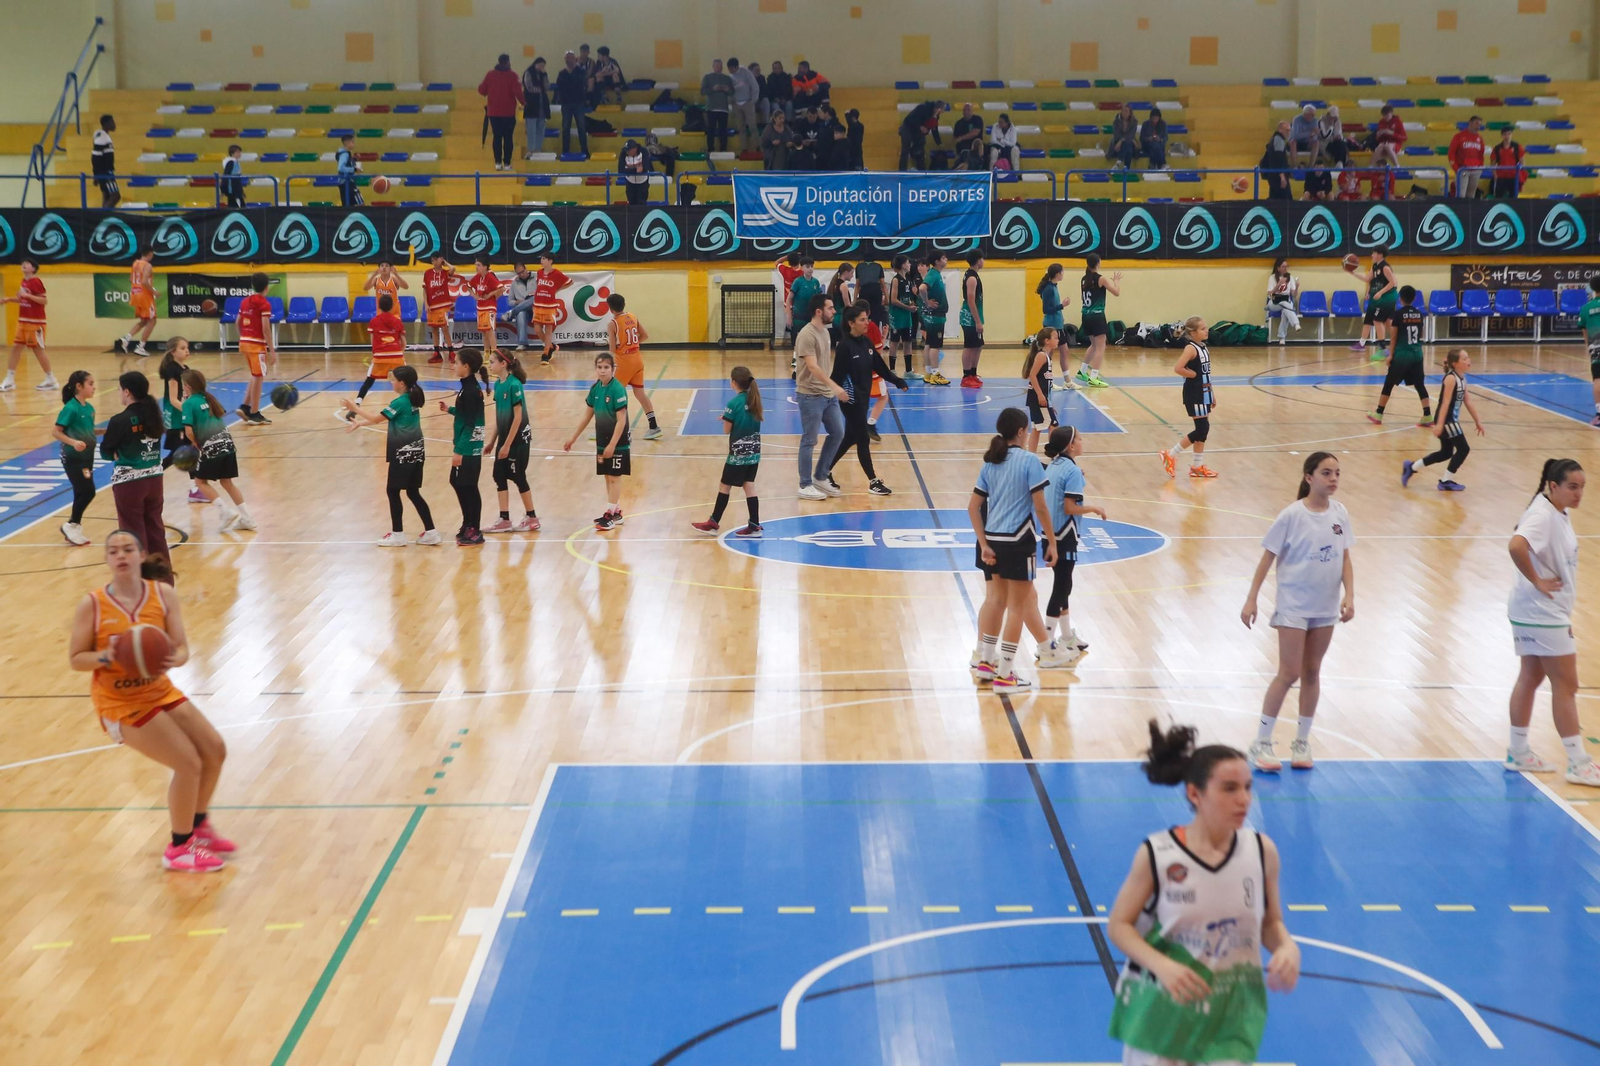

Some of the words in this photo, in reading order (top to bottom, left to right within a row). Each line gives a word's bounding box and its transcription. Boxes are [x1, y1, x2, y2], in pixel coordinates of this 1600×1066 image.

[805, 184, 892, 206] Diputación
[908, 187, 985, 203] DEPORTES
[806, 211, 826, 227] de
[832, 210, 877, 227] Cádiz
[1567, 270, 1580, 280] DE
[538, 278, 555, 288] PALO
[104, 291, 130, 303] GPO
[172, 285, 184, 296] tu
[186, 285, 212, 296] fibra
[213, 287, 228, 297] en
[229, 287, 255, 297] casa
[172, 305, 187, 313] 956
[188, 305, 202, 313] 762
[1507, 317, 1537, 330] LIBR
[452, 332, 509, 340] INFUSIES
[625, 327, 639, 345] 16
[1406, 325, 1419, 345] 13
[510, 462, 517, 473] 4
[612, 458, 622, 469] 15
